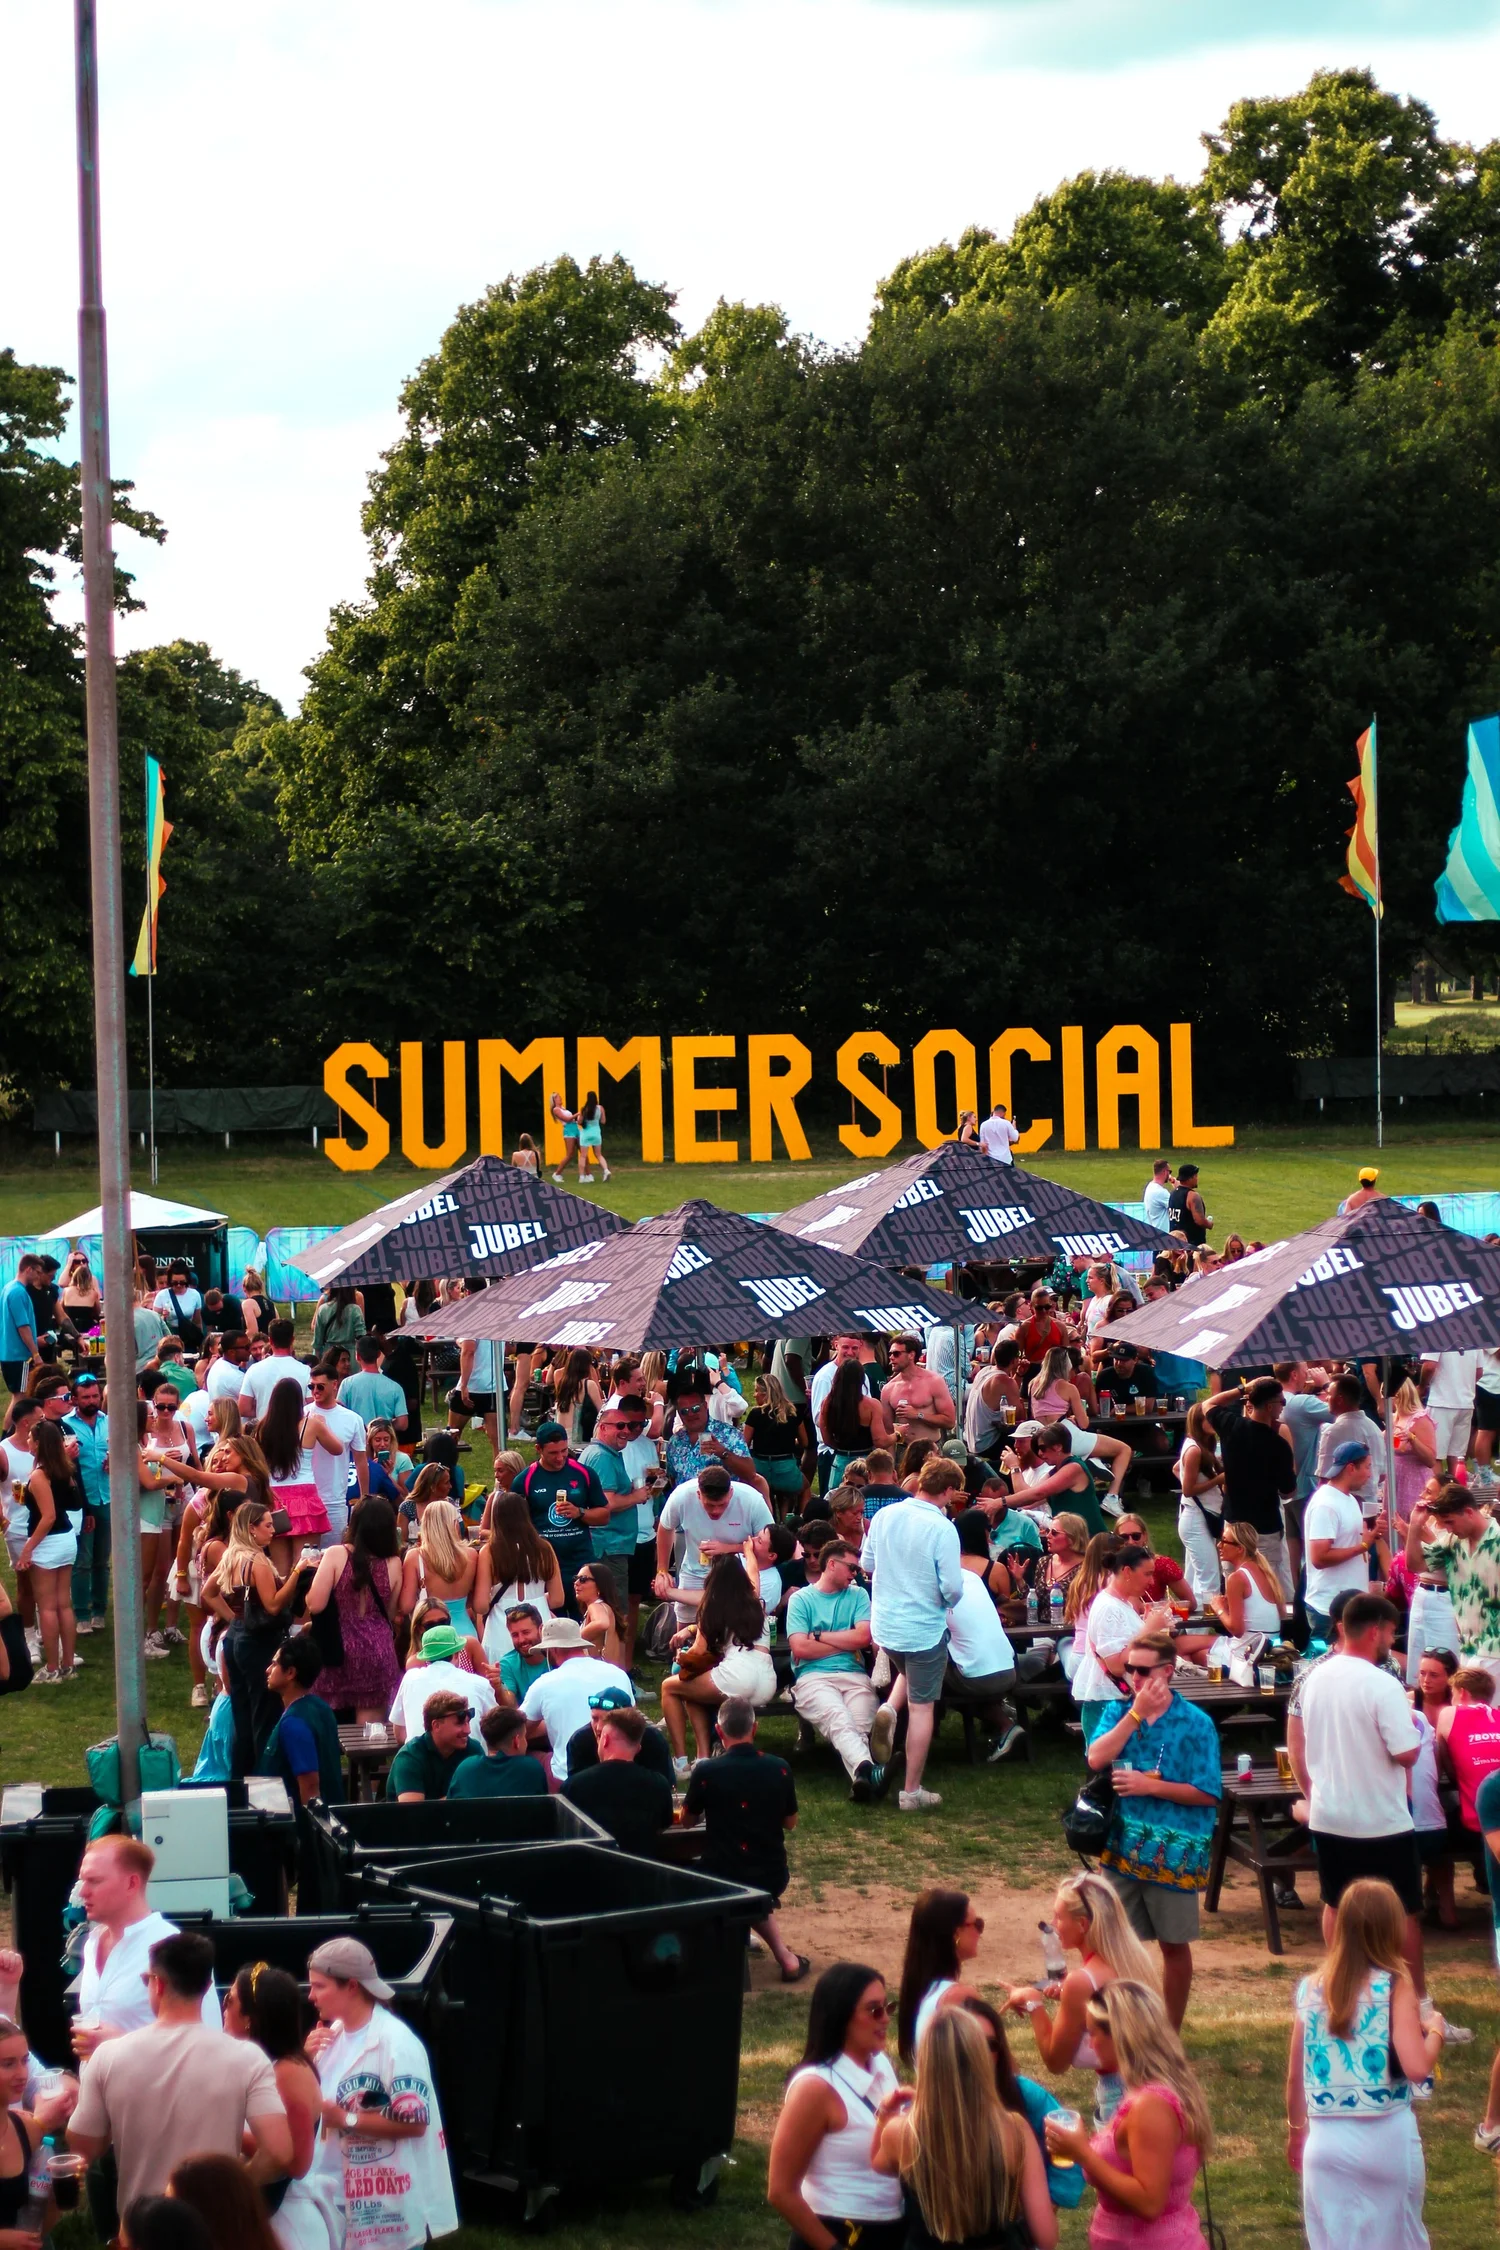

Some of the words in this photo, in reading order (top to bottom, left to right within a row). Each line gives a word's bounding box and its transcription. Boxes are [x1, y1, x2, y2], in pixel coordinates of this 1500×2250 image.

[324, 1033, 812, 1171] SUMMER
[836, 1022, 1235, 1158] SOCIAL
[393, 1193, 460, 1229] UBEL
[887, 1178, 944, 1214] UBEL
[468, 1221, 548, 1260] JUBEL
[958, 1206, 1036, 1243] JUBEL
[662, 1244, 713, 1287] UBEL
[1287, 1247, 1365, 1293] UBEL
[738, 1276, 827, 1318] JUBEL
[1289, 1271, 1388, 1318] JUBEL
[1381, 1281, 1484, 1330] JUBEL
[363, 2167, 397, 2177] FLAKE
[375, 2173, 411, 2196] OATS
